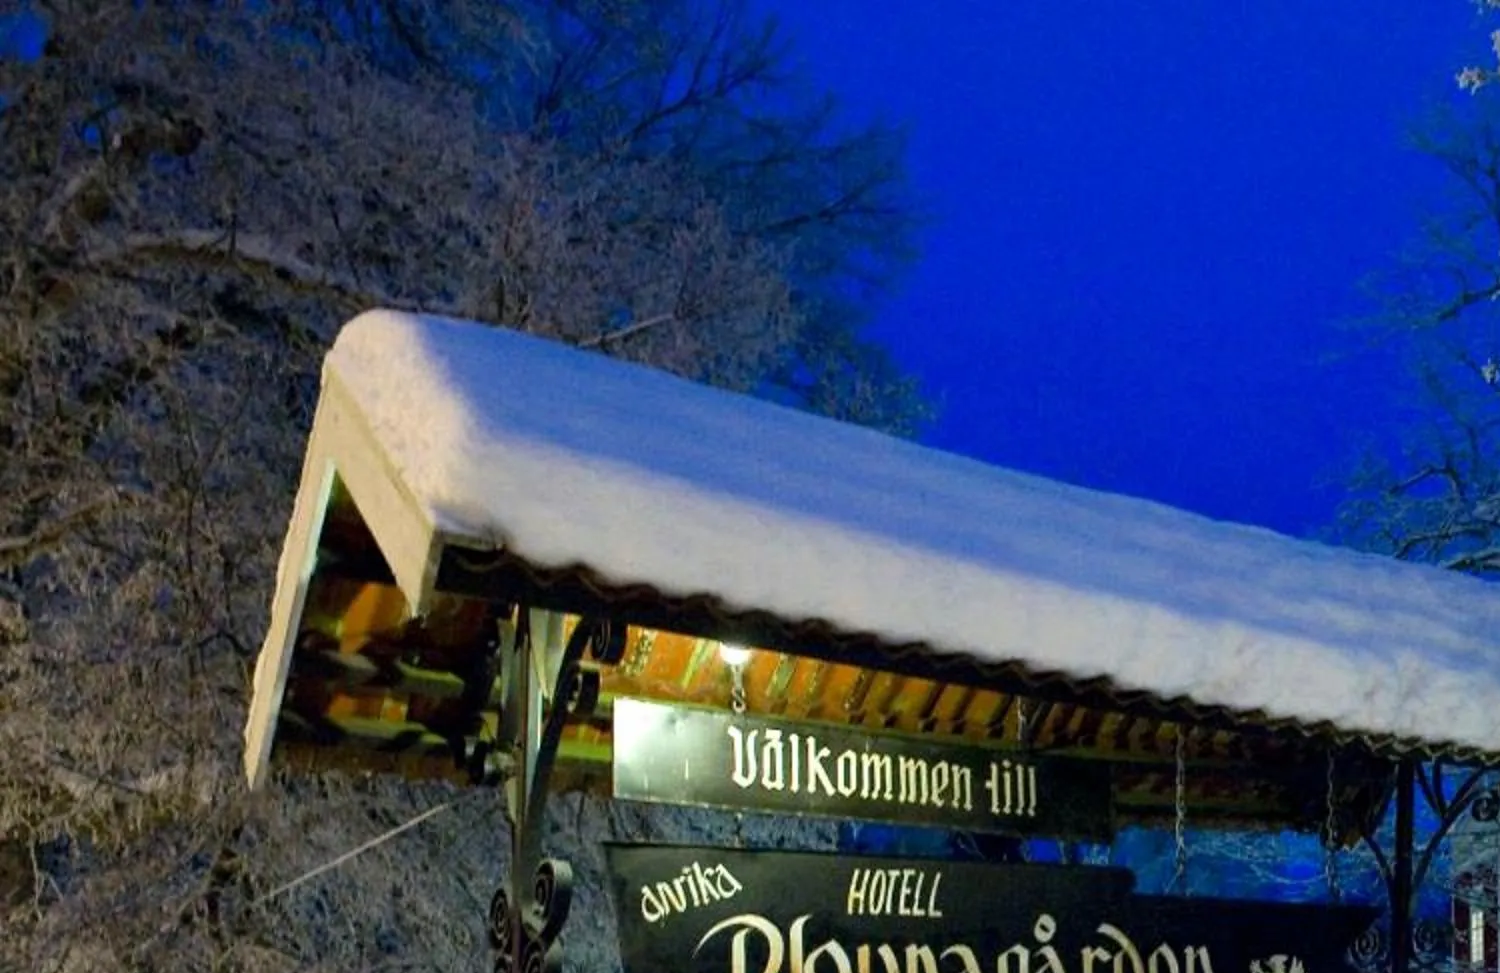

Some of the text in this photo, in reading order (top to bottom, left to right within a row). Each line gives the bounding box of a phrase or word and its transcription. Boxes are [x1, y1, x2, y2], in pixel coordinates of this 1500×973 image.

[727, 724, 1038, 817] Välkommen till
[846, 867, 943, 918] HOTELL
